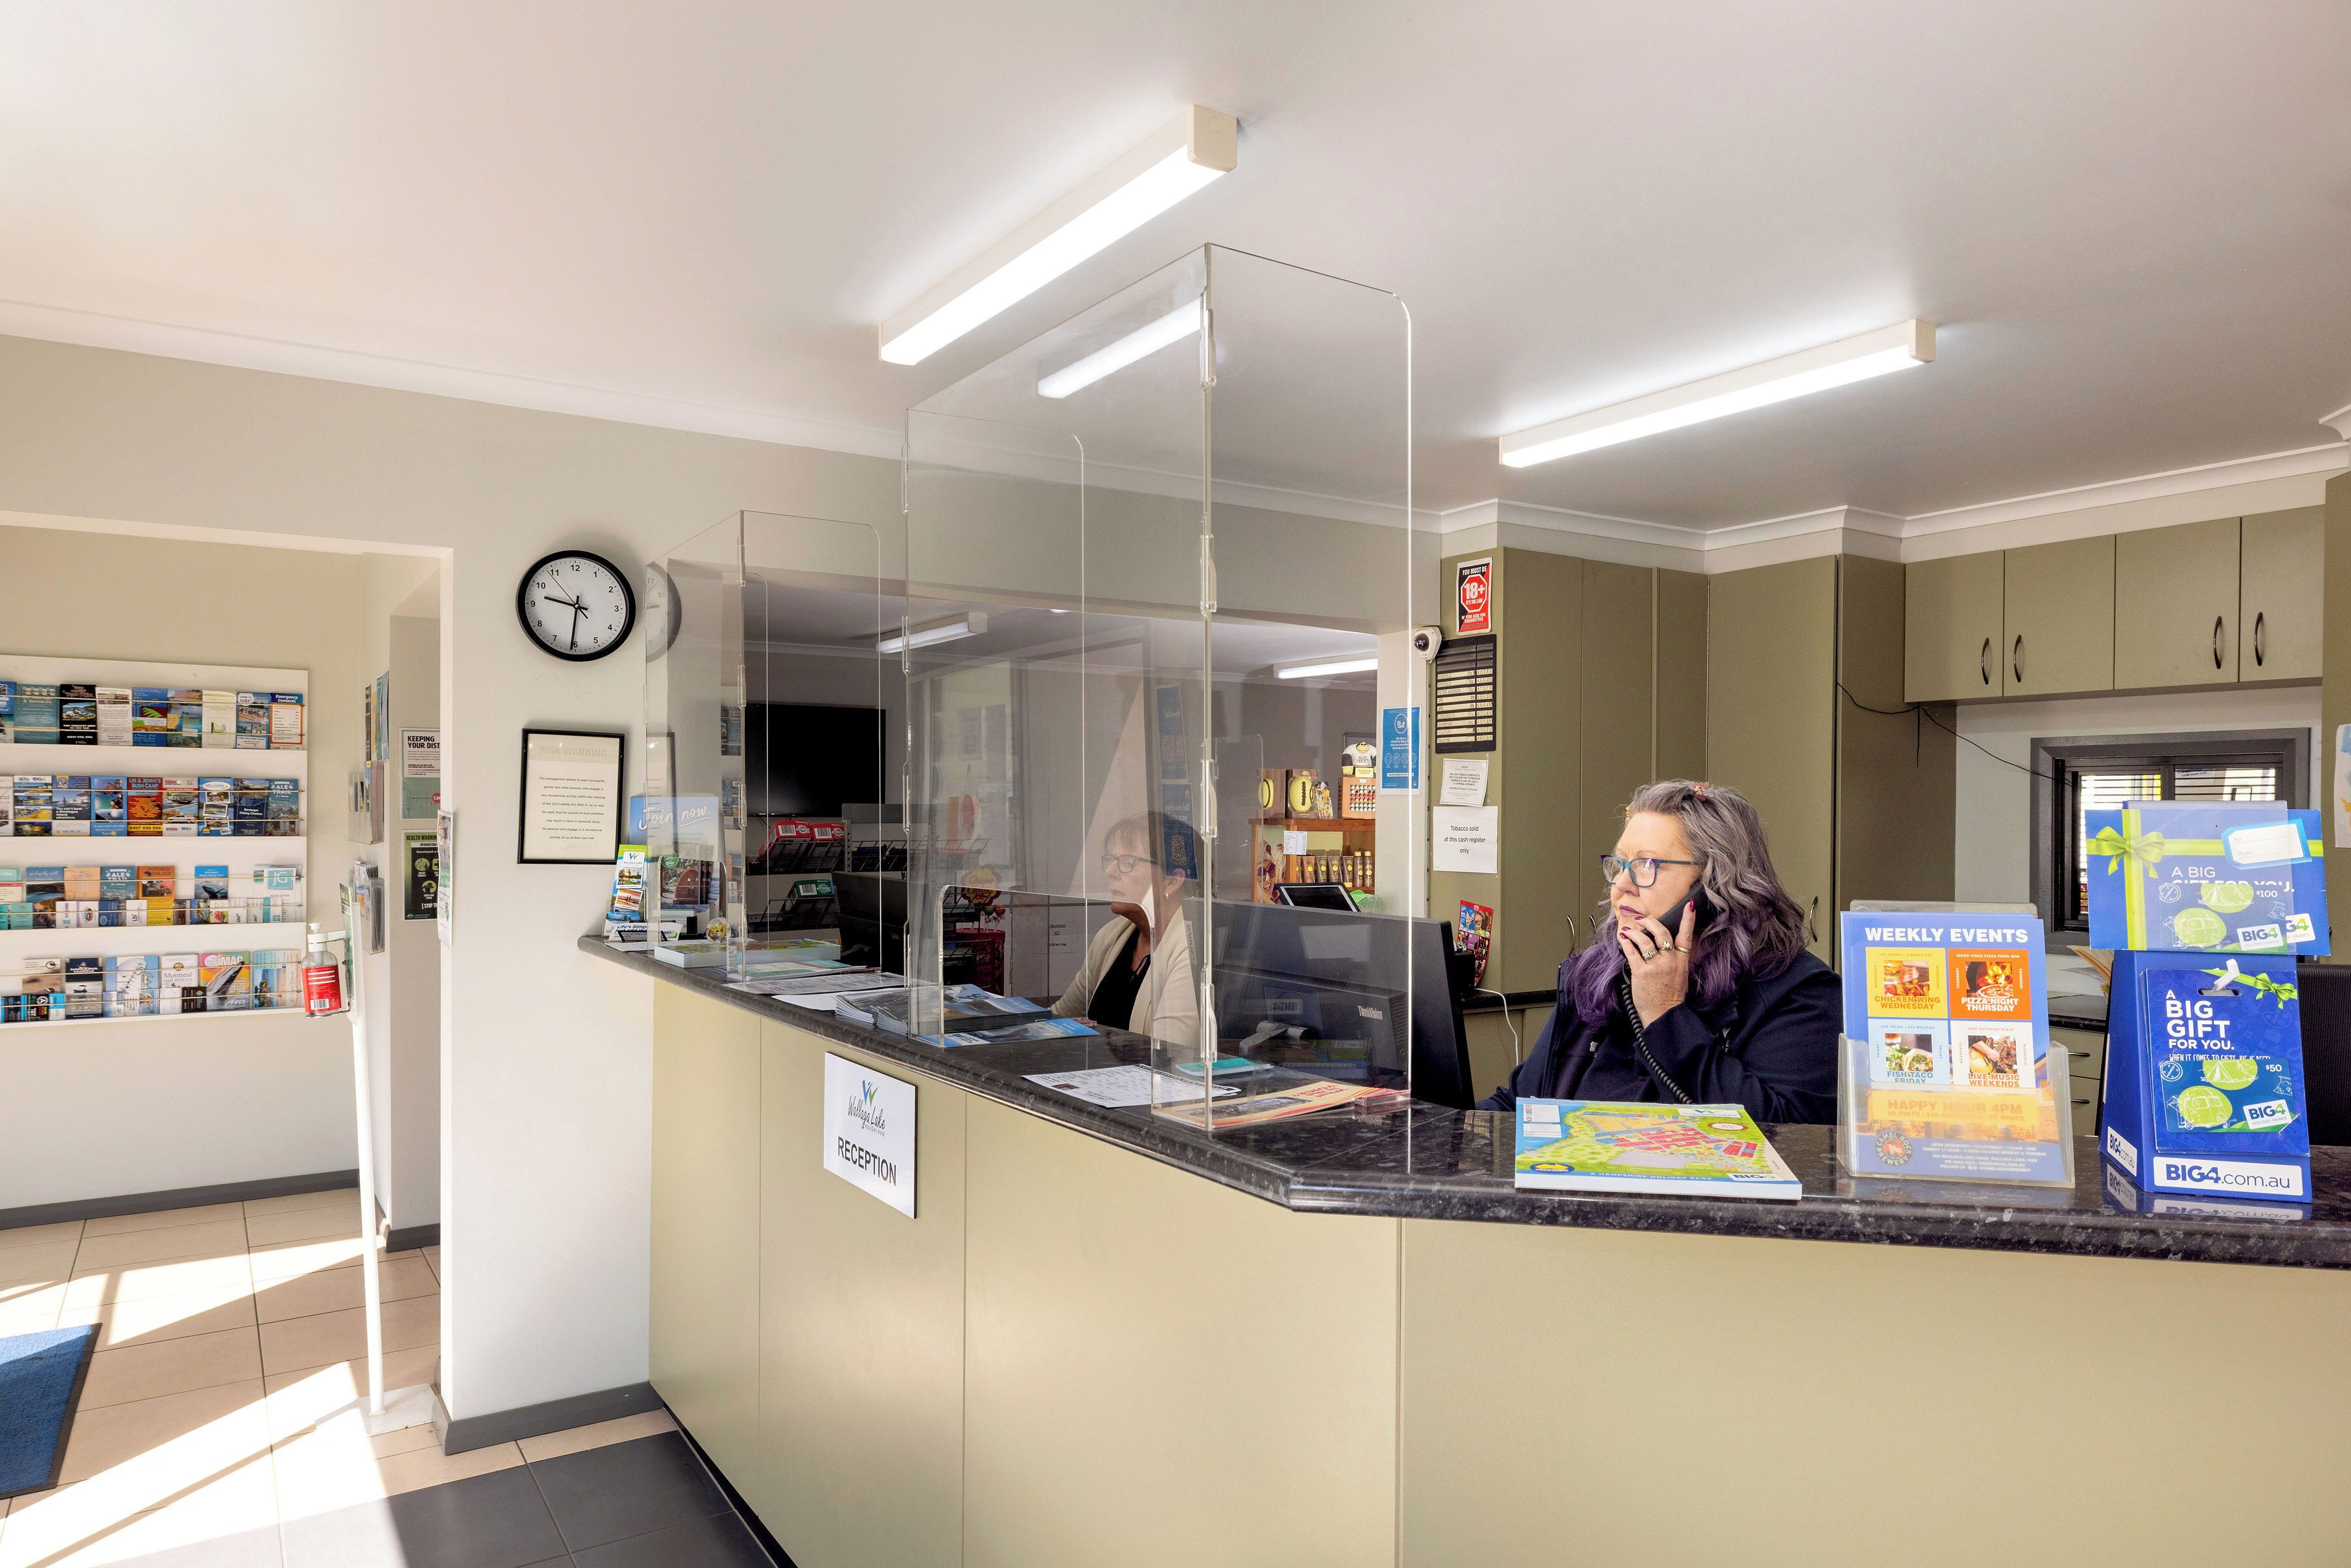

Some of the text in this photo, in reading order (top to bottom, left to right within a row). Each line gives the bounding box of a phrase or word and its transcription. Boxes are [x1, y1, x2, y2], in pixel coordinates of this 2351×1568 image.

[1463, 582, 1485, 600] 18+
[539, 746, 607, 758] RISK WARNING
[639, 805, 707, 830] Join now
[272, 872, 288, 886] JG
[2171, 867, 2216, 878] A BIG
[1864, 927, 2028, 943] WEEKLY EVENTS
[2242, 927, 2279, 942] BIG4
[2166, 989, 2176, 999] A
[1358, 1005, 1383, 1021] ThinkVision
[2166, 1000, 2213, 1018] BIG
[2166, 1019, 2230, 1038] GIFT
[2168, 1038, 2235, 1050] FOR YOU.
[2265, 1064, 2282, 1072] $50
[848, 1095, 886, 1129] Wallaga Lake
[1887, 1099, 2023, 1114] HAPPY HOUR 4PM
[2248, 1104, 2286, 1119] BIG4
[865, 1124, 877, 1134] HOLIDAY
[1876, 1132, 1913, 1155] CAMEL ROCK
[2109, 1133, 2135, 1169] BIG4.com.au
[838, 1136, 896, 1186] RECEPTION
[1876, 1147, 1909, 1166] BREWERY
[2166, 1164, 2290, 1189] BIG4.com.au
